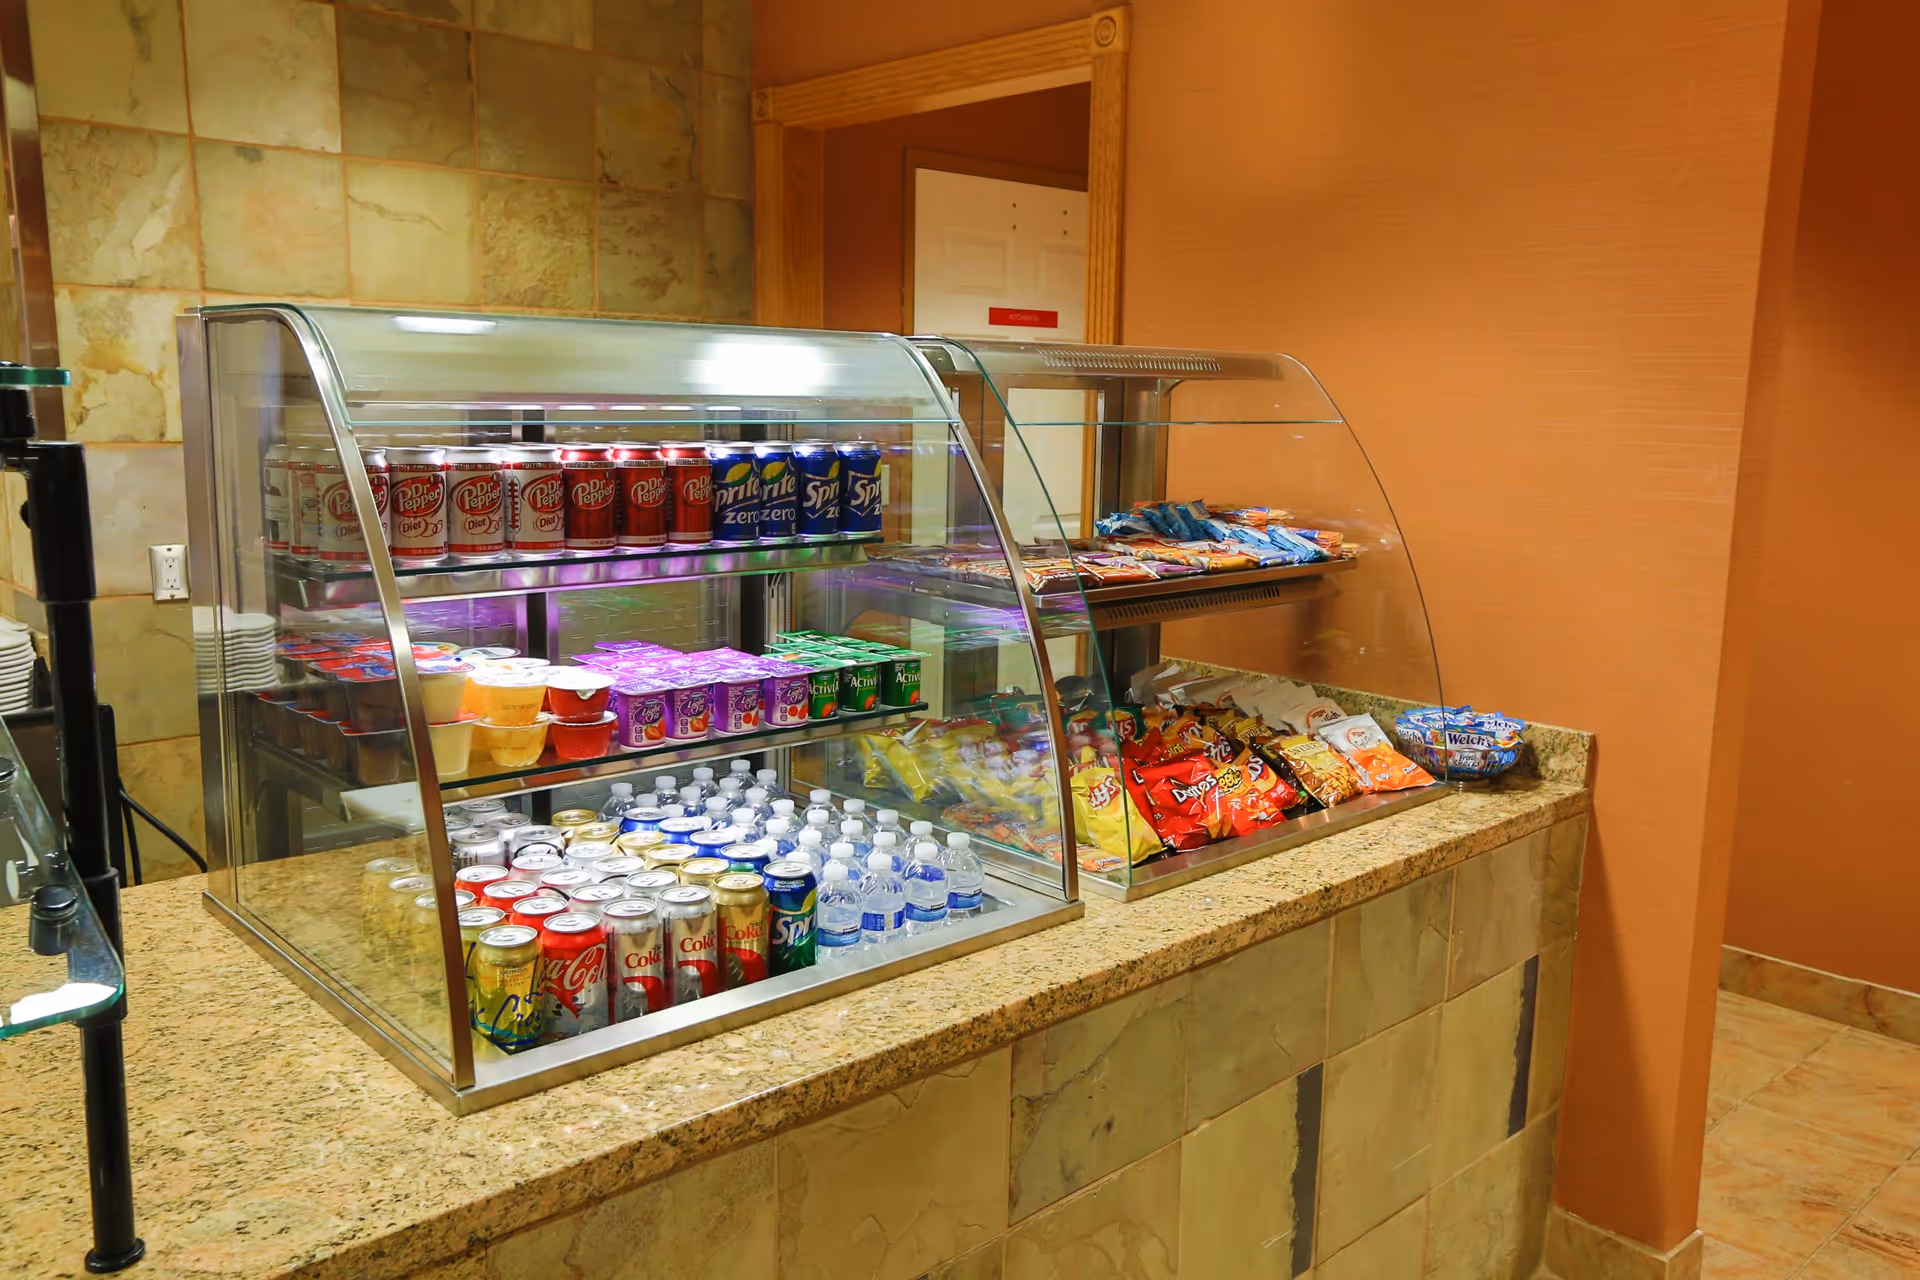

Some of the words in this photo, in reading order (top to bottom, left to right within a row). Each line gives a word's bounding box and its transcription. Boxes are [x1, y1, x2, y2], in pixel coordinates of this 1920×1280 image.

[412, 483, 430, 499] Dr
[476, 480, 494, 497] Dr
[535, 484, 563, 509] Pepp
[577, 483, 613, 506] Pepper
[590, 479, 606, 494] Dr
[637, 482, 666, 505] Peppe
[688, 480, 712, 502] Pepp
[714, 472, 760, 513] prite
[761, 471, 796, 502] rite
[850, 479, 882, 509] Spr
[399, 488, 440, 513] Pepper
[464, 485, 501, 511] Pepper
[467, 518, 487, 531] Diet
[539, 516, 557, 529] Diet
[723, 510, 760, 525] zero
[760, 508, 796, 521] zero
[402, 519, 422, 534] Diet
[1447, 732, 1492, 749] Welch's
[1172, 774, 1218, 804] Doritos
[726, 924, 763, 941] Coke
[772, 915, 816, 949] Spr
[679, 934, 717, 953] Coke
[624, 949, 662, 969] Coke
